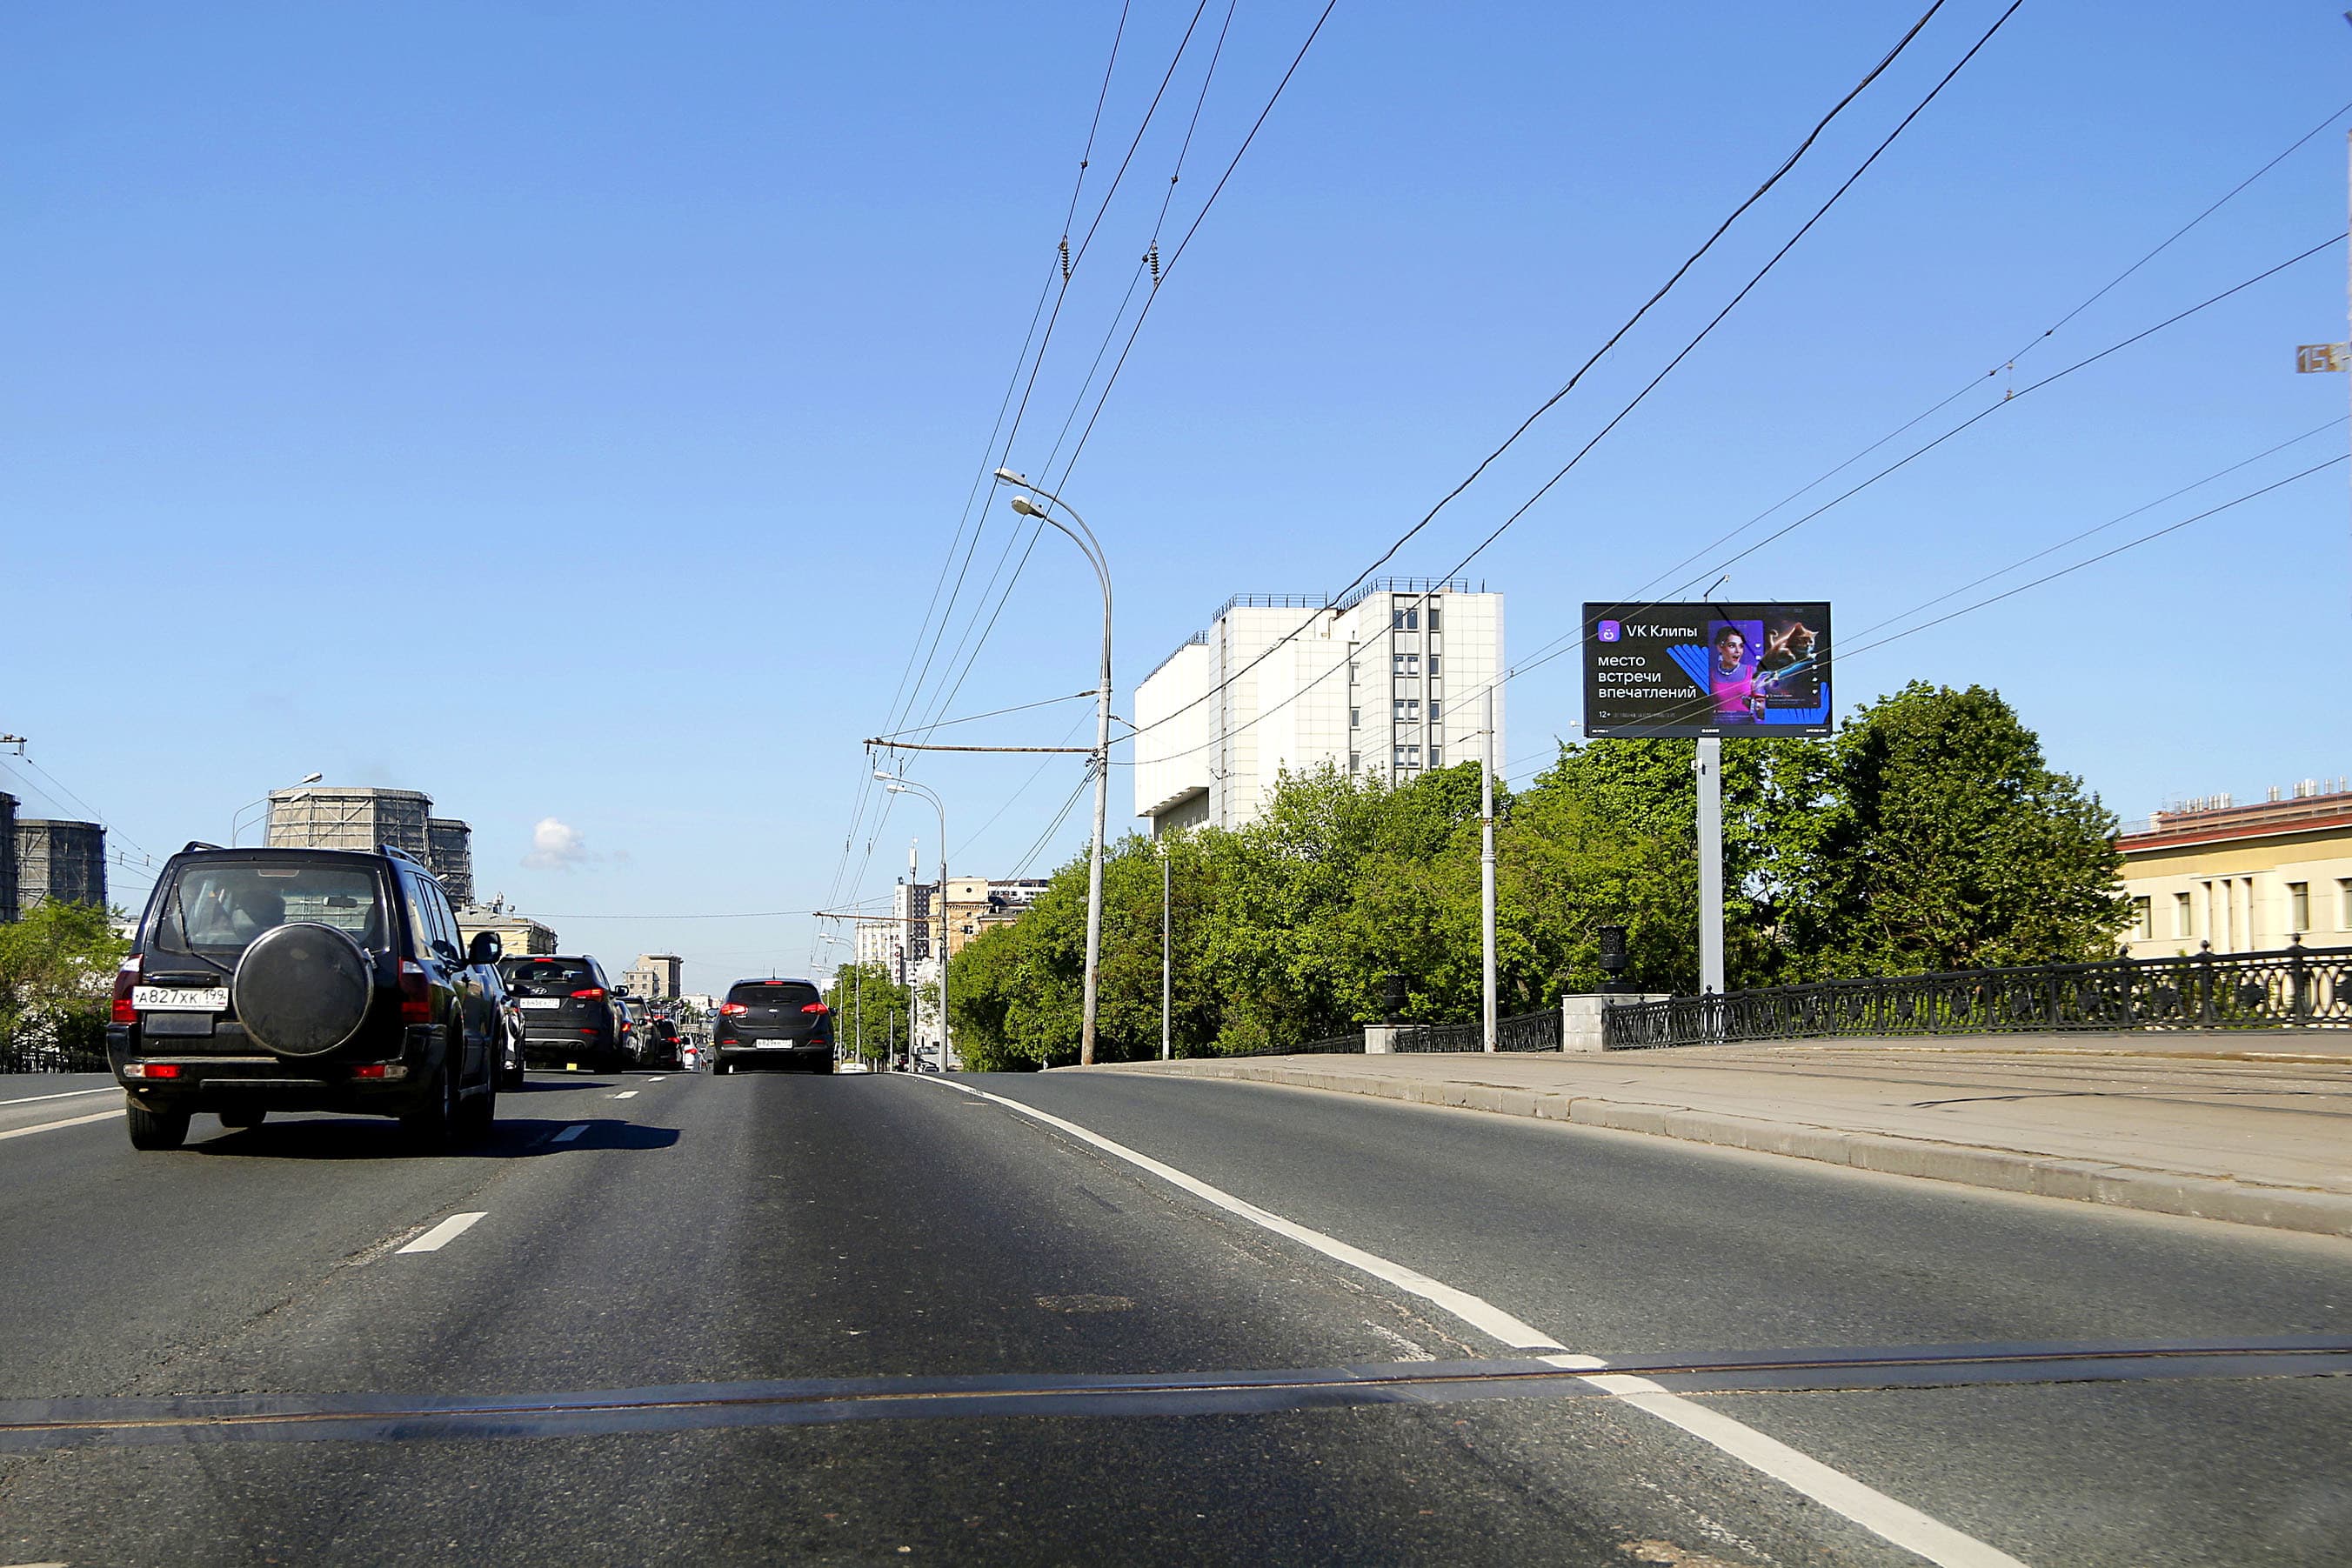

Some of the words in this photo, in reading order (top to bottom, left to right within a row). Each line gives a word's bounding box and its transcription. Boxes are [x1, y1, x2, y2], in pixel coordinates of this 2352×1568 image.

[1626, 624, 1647, 637] VK
[1650, 624, 1698, 637] Клипы
[1598, 657, 1646, 666] место
[1598, 672, 1661, 685] встречи
[1599, 685, 1697, 698] впечатлений
[139, 990, 198, 1004] А827ХК
